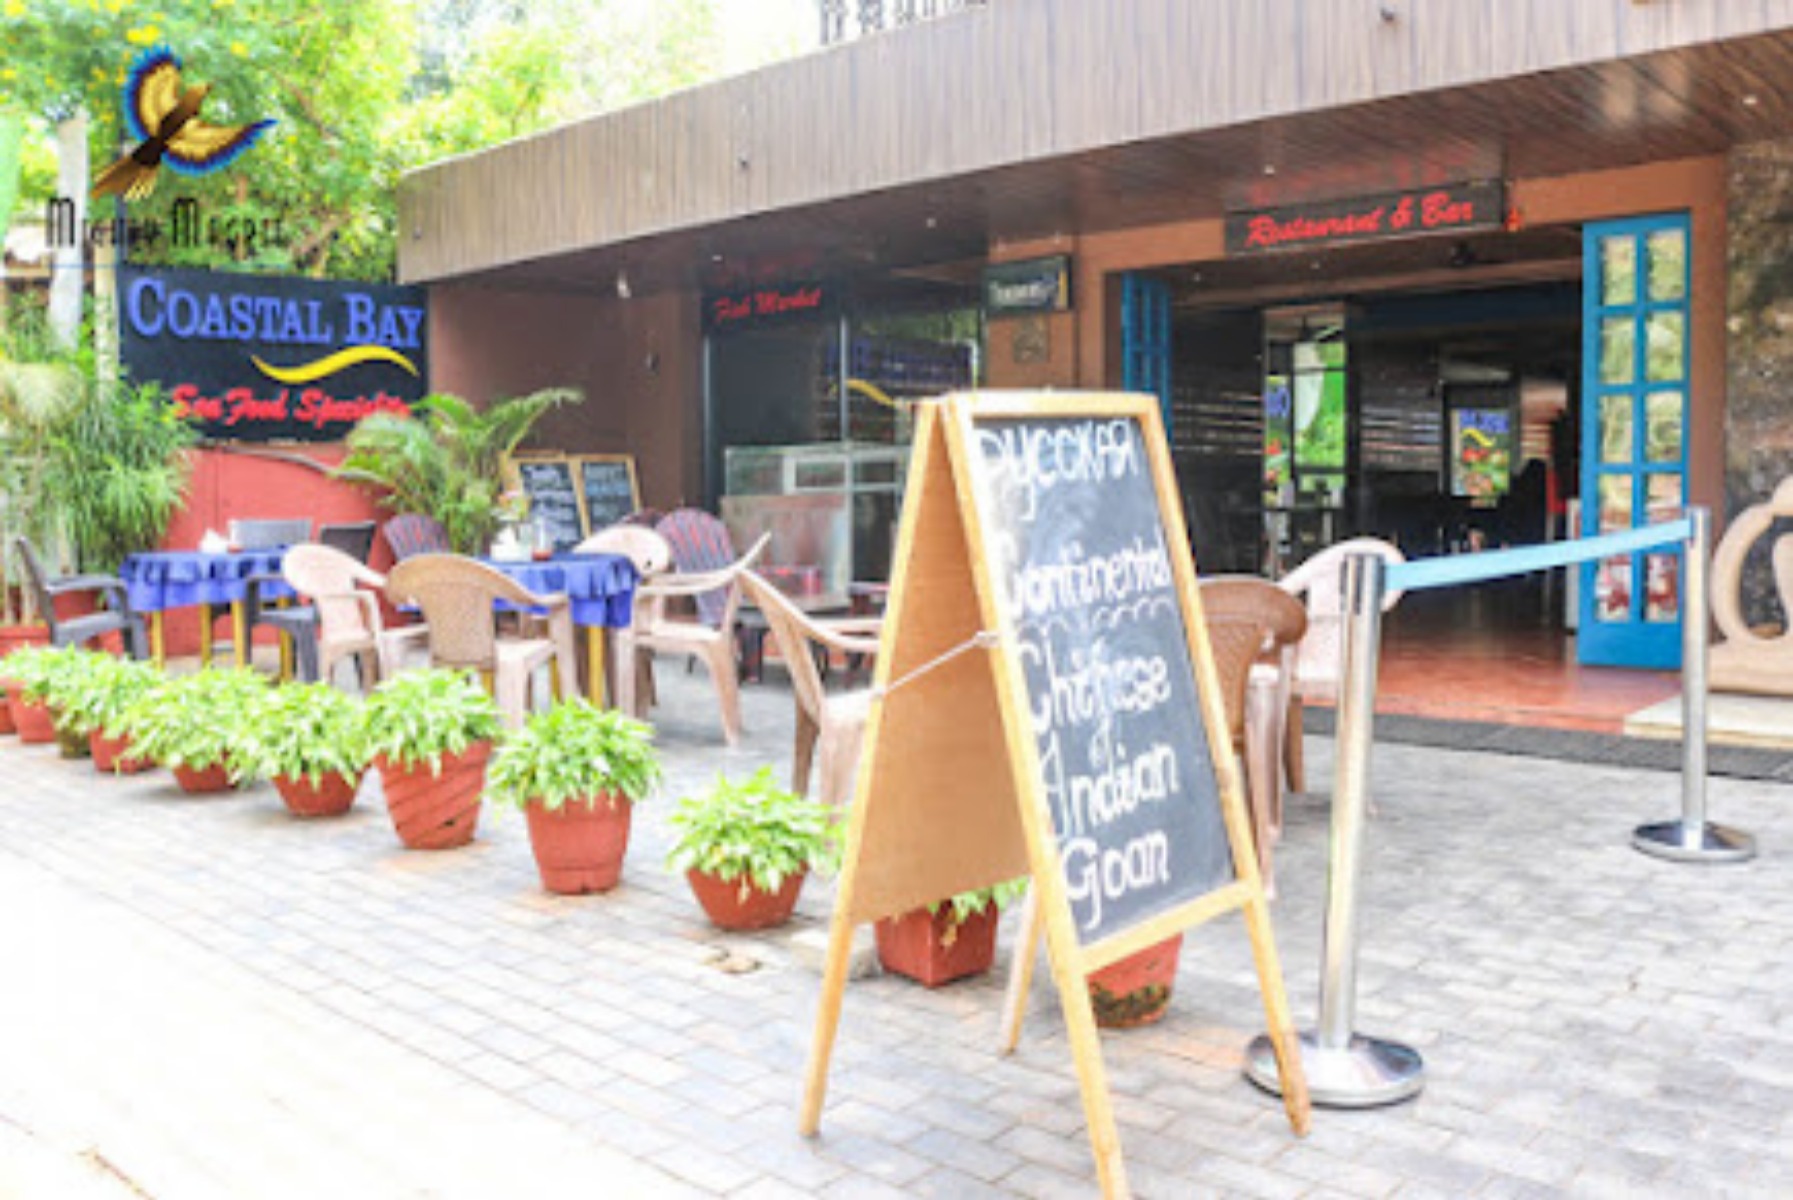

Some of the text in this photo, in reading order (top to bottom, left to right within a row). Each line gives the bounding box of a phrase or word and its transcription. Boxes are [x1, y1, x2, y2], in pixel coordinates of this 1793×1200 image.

[1245, 206, 1385, 247] Restaurant
[1421, 191, 1473, 227] Bar
[127, 276, 424, 348] COASTAL BAY
[171, 382, 225, 421] Sea
[223, 386, 290, 427] Food
[1063, 829, 1170, 930] Goan
